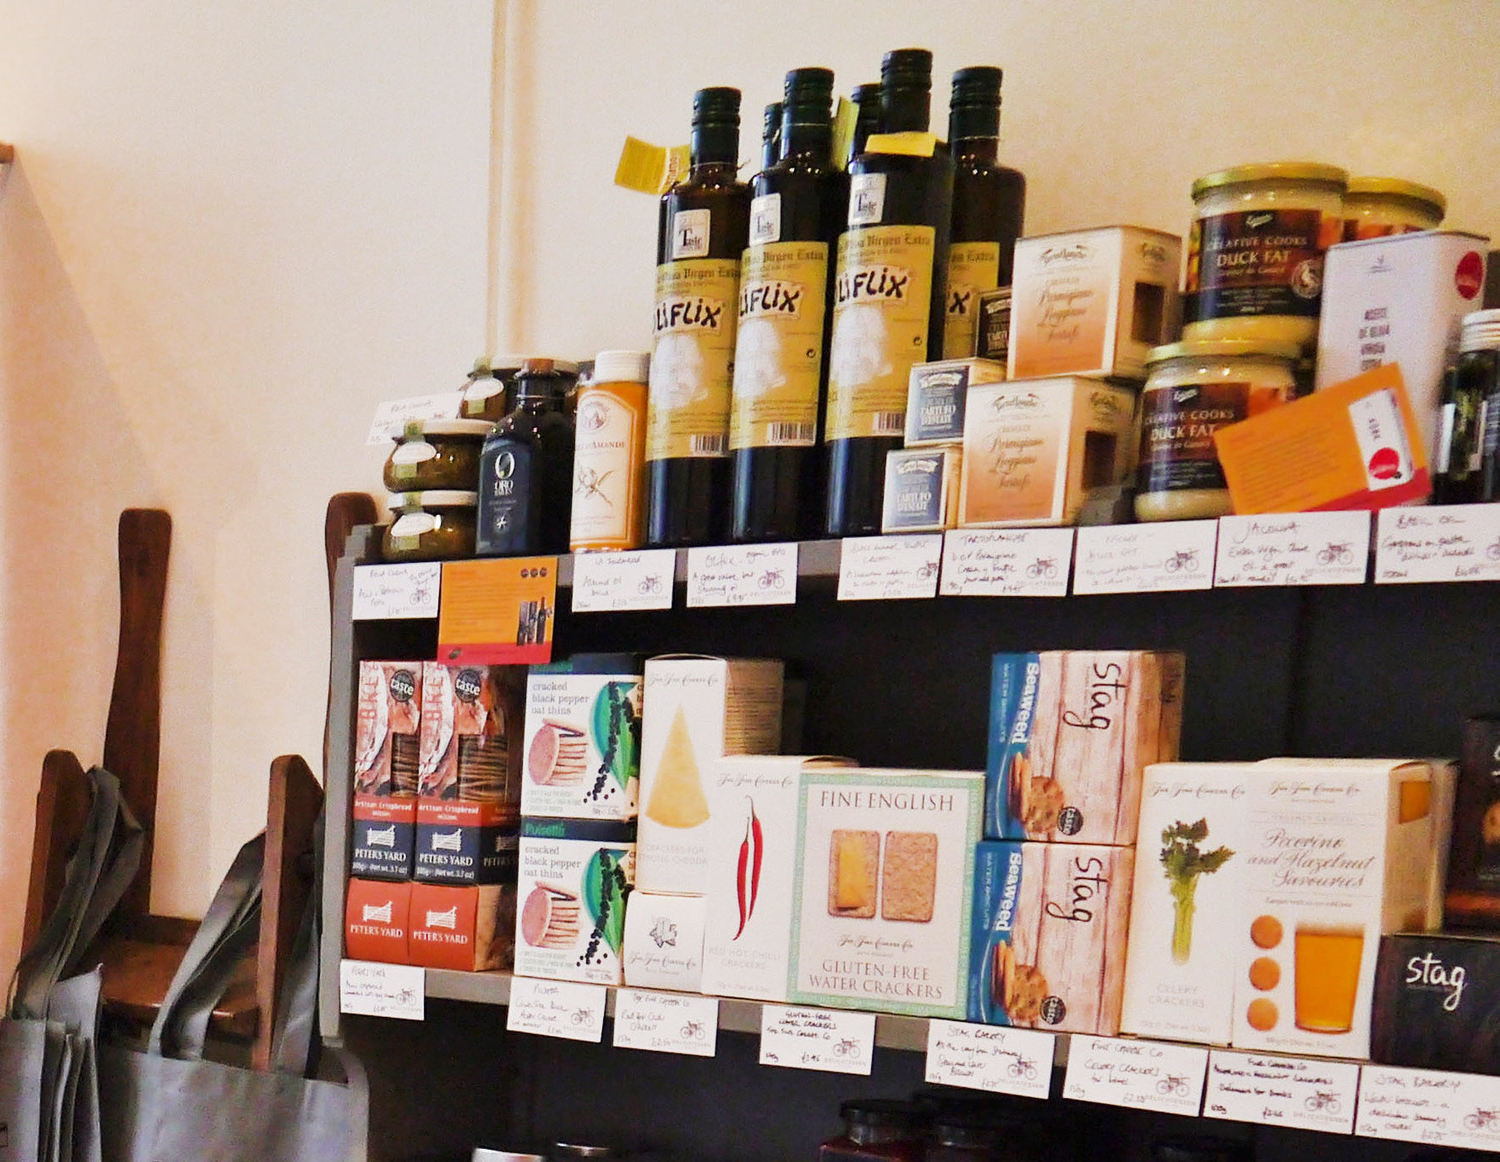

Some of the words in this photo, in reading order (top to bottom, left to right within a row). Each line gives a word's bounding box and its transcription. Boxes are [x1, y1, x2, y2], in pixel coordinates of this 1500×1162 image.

[1216, 252, 1260, 267] DUCK
[1264, 250, 1292, 264] FAT
[1150, 426, 1186, 441] DUCK
[533, 681, 567, 692] cracked
[532, 693, 560, 704] black
[563, 694, 588, 706] pepper
[1011, 661, 1040, 745] Seaweed
[531, 706, 545, 715] oat
[548, 705, 571, 715] thins
[821, 791, 862, 809] FINE
[868, 792, 954, 811] ENGLISH
[1264, 829, 1343, 849] Pecorino
[381, 850, 406, 862] YARD
[525, 845, 559, 856] cracked
[446, 855, 473, 867] YARD
[525, 856, 551, 867] black
[554, 859, 581, 871] pepper
[672, 855, 708, 865] CHEDDA
[1247, 854, 1279, 867] and
[1283, 852, 1375, 879] Hazelnut
[524, 870, 538, 879] oat
[541, 869, 563, 879] thins
[994, 852, 1022, 932] Seaweed
[379, 928, 403, 938] YARD
[443, 934, 468, 944] YARD
[822, 959, 930, 981] GLUTEN-FREE
[809, 975, 859, 993] WATER
[863, 979, 942, 998] CRACKERS
